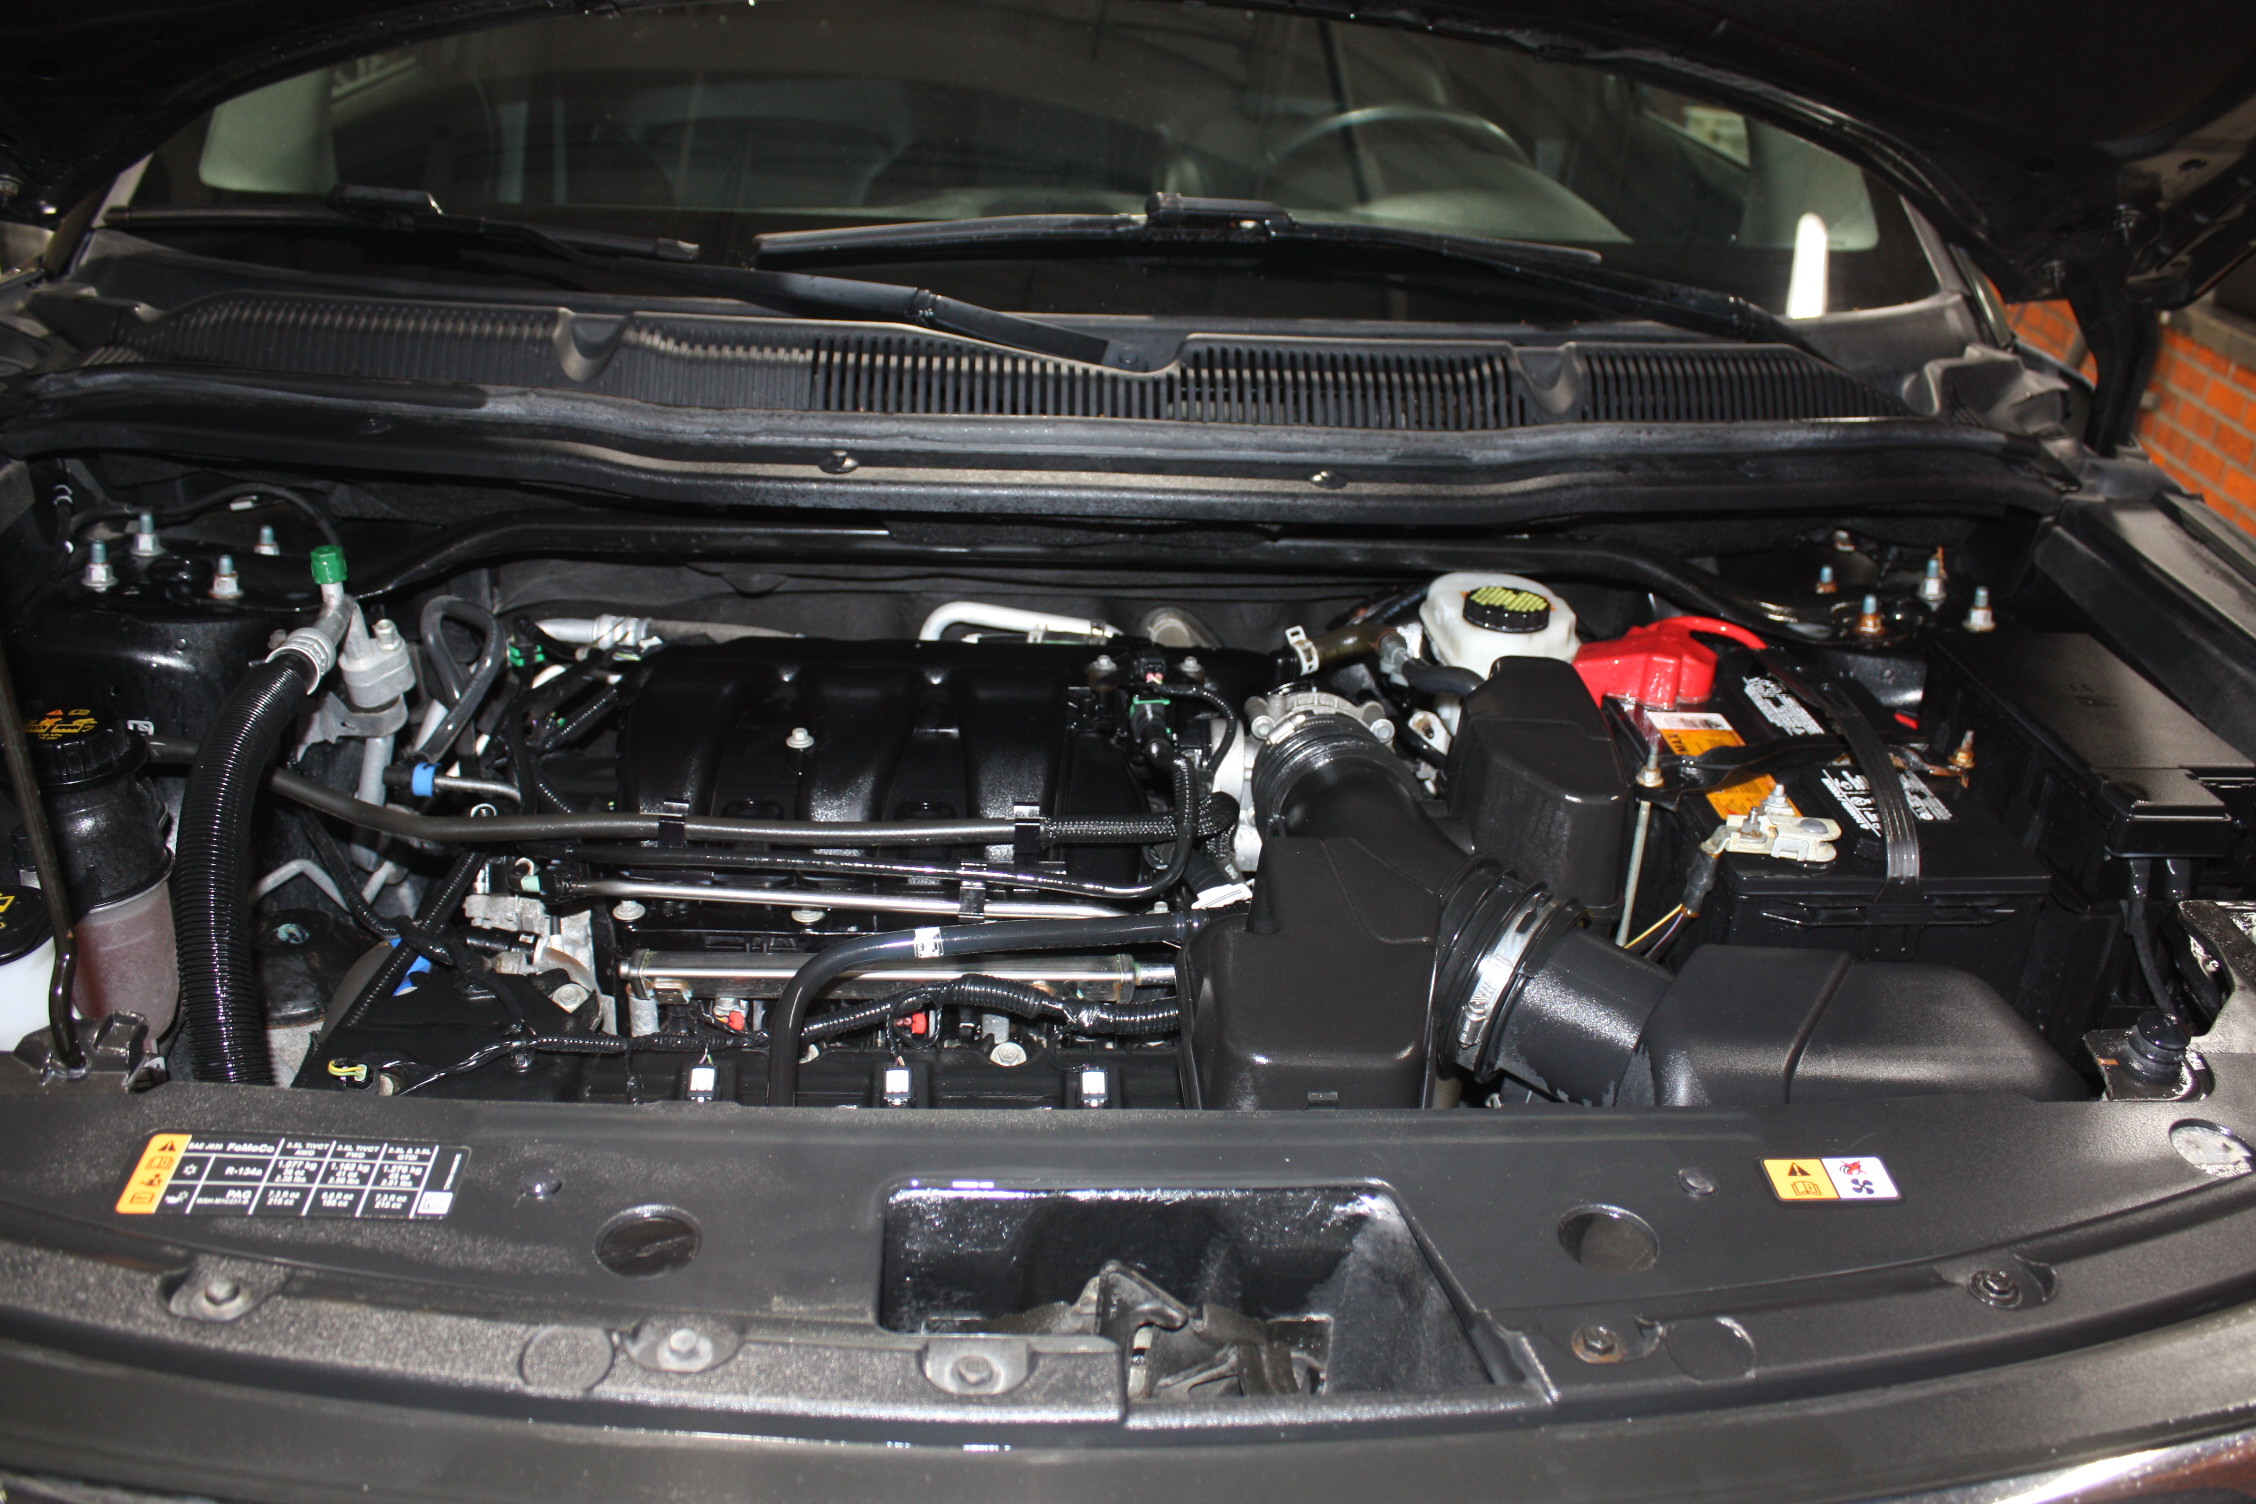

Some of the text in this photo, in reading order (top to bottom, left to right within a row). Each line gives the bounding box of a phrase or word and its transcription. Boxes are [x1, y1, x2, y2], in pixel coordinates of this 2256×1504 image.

[226, 1142, 275, 1153] FoMoCo
[345, 1151, 366, 1159] FWD
[224, 1166, 263, 1176] R-134a
[277, 1160, 318, 1172] 1.077 kg
[330, 1162, 370, 1173] 1.162 kg
[383, 1164, 423, 1176] 1.276 kg
[225, 1189, 252, 1199] PAG
